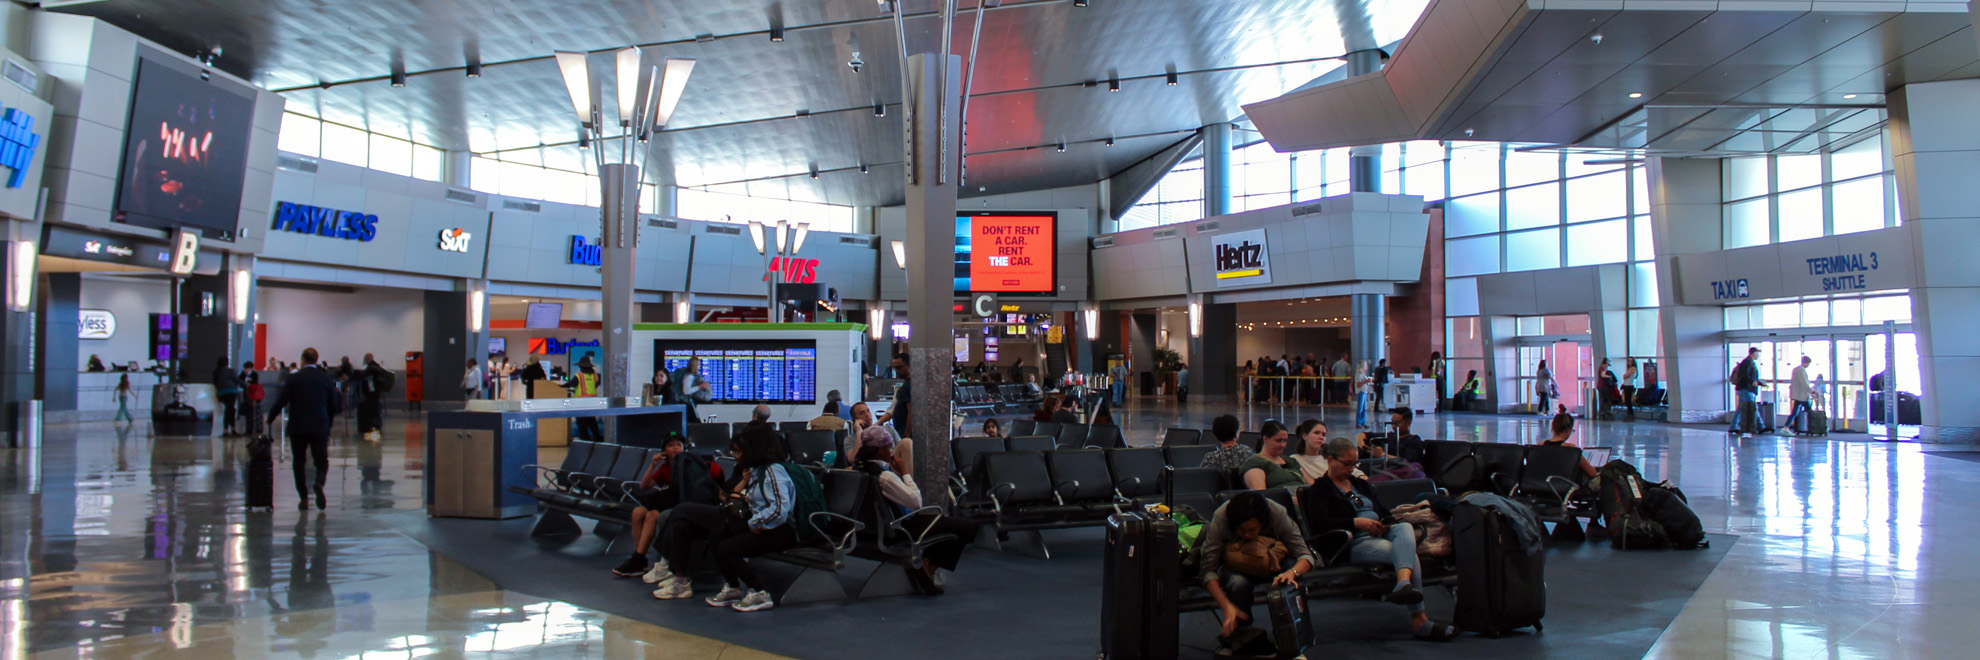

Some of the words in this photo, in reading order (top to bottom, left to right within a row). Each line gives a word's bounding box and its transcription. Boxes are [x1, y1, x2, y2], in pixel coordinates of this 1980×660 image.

[272, 201, 379, 242] PAYLESS
[982, 226, 1012, 235] DON'T
[1015, 226, 1040, 235] RENT
[995, 236, 1002, 245] A
[1004, 236, 1028, 246] CAR.
[998, 246, 1024, 255] RENT
[172, 232, 198, 275] B
[988, 256, 1009, 267] THE
[1010, 257, 1033, 266] CAR.
[1216, 240, 1262, 271] Hertz
[1806, 253, 1868, 276] TERMINAL
[1870, 252, 1878, 270] 3
[763, 256, 820, 284] AVIS
[1711, 280, 1737, 300] TAXI
[1822, 275, 1866, 292] SHUTTLE
[975, 295, 993, 317] C
